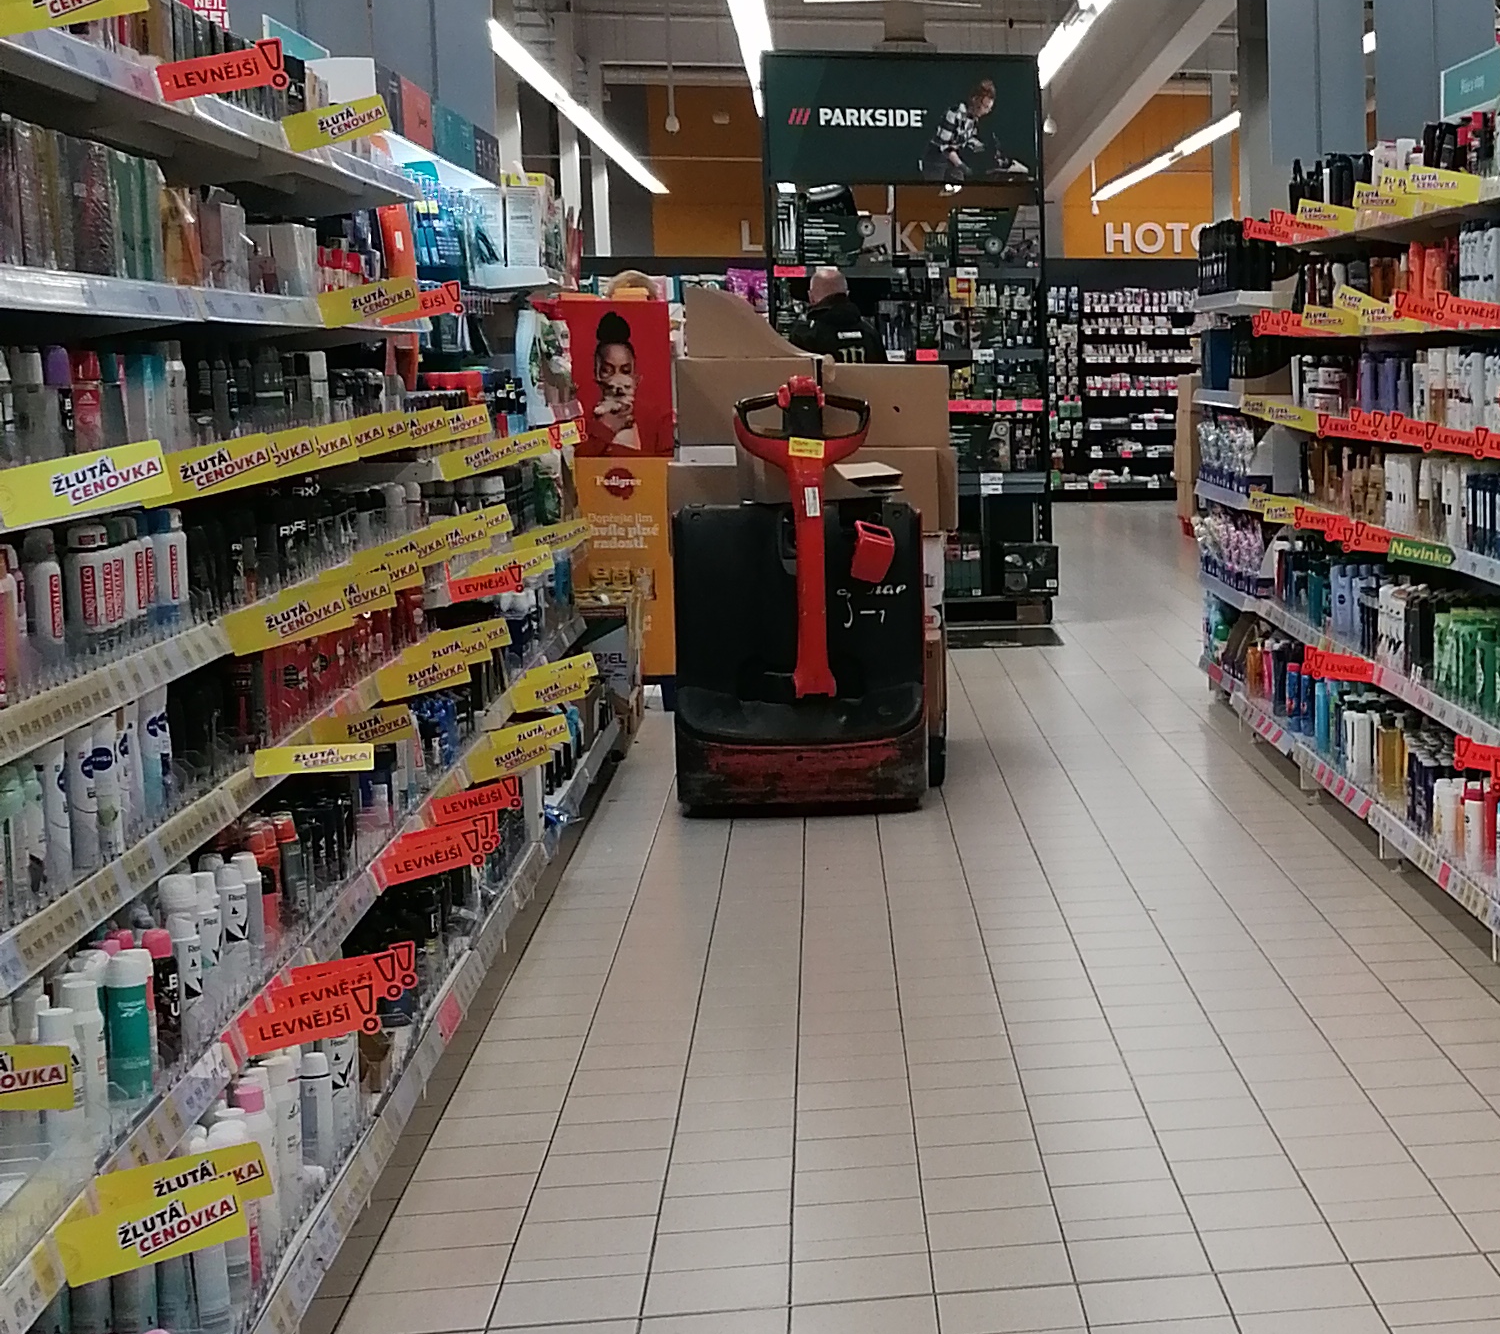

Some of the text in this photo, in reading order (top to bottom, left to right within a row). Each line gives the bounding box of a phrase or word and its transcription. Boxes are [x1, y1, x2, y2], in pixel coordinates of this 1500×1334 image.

[173, 58, 260, 89] LEVNĚJŠÍ
[318, 109, 354, 132] ŽLUTÁ
[331, 108, 384, 136] CENOVKA
[819, 108, 923, 128] PARKSIDE
[352, 288, 385, 311] ŽLUTÁ
[362, 288, 414, 315] CENOVKA
[1450, 304, 1499, 320] LEVNĚJŠÍ
[53, 457, 113, 493] ŽLUTÁ
[180, 450, 229, 481] ŽLUTÁ
[196, 450, 267, 487] CENOVKA
[71, 461, 158, 502] CENOVKA
[1390, 541, 1452, 563] Novinka
[266, 603, 308, 628] ŽLUTÁ
[280, 601, 341, 636] CENOVKA
[408, 665, 439, 685] ŽLUTÁ
[418, 663, 464, 688] CENOVKA
[347, 716, 382, 736] ŽLUTÁ
[359, 716, 408, 741] CENOVKA
[294, 748, 336, 763] ŽLUTÁ
[305, 751, 369, 767] CENOVKA
[443, 789, 502, 815] LEVNĚJŠÍ
[394, 842, 462, 874] LEVNĚJŠÍ
[258, 1004, 352, 1041] LEVNĚJŠÍ
[0, 1067, 63, 1088] OVKA
[154, 1160, 214, 1197] ŽLUTÁ
[119, 1200, 185, 1245] ŽLUTÁ
[138, 1198, 233, 1253] CENOVKA
